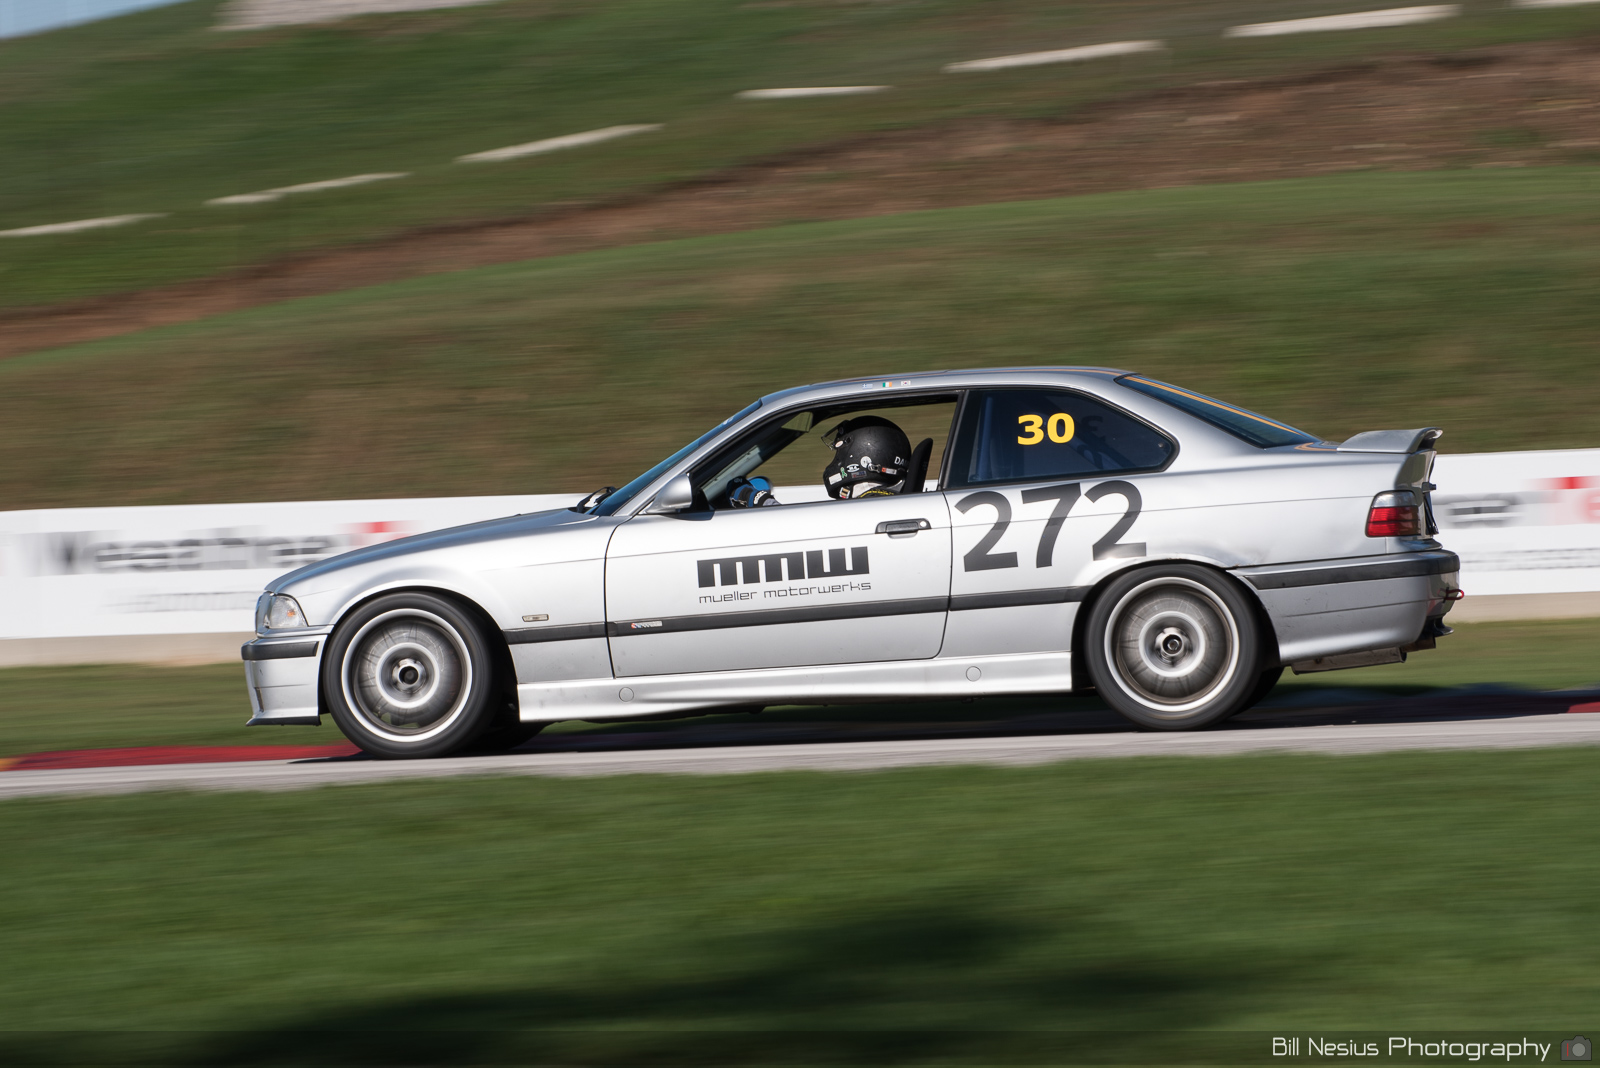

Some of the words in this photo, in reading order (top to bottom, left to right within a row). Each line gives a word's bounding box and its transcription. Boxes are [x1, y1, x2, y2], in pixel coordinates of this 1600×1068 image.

[1017, 412, 1075, 446] 30
[954, 480, 1147, 573] 272
[698, 589, 758, 604] mueller
[763, 580, 872, 599] motorwerks
